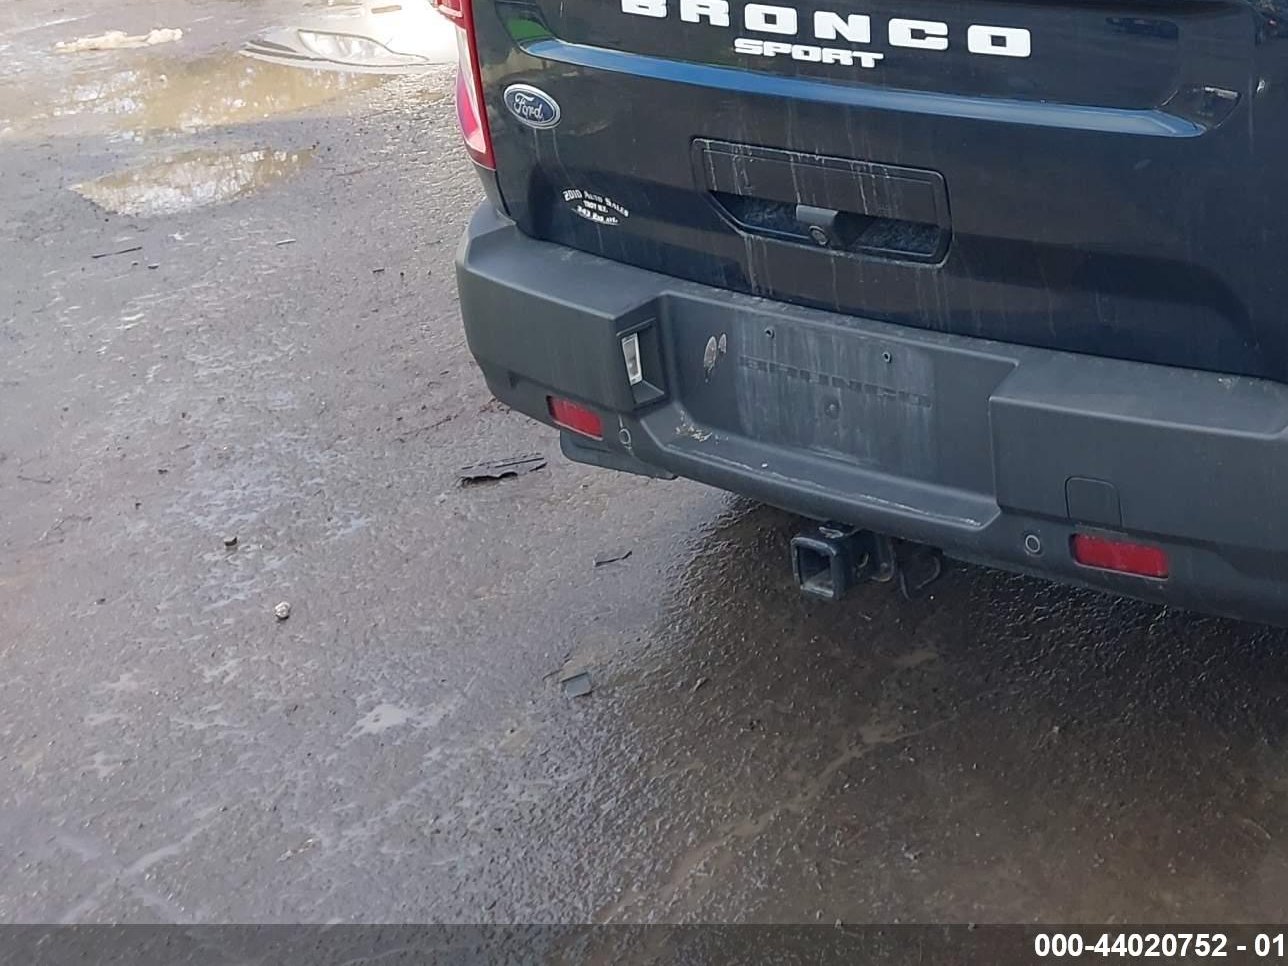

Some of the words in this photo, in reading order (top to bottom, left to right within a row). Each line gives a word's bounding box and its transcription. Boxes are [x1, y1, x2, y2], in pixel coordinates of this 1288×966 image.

[734, 38, 884, 68] SPORT
[513, 92, 545, 122] Ford
[562, 189, 583, 202] 2010
